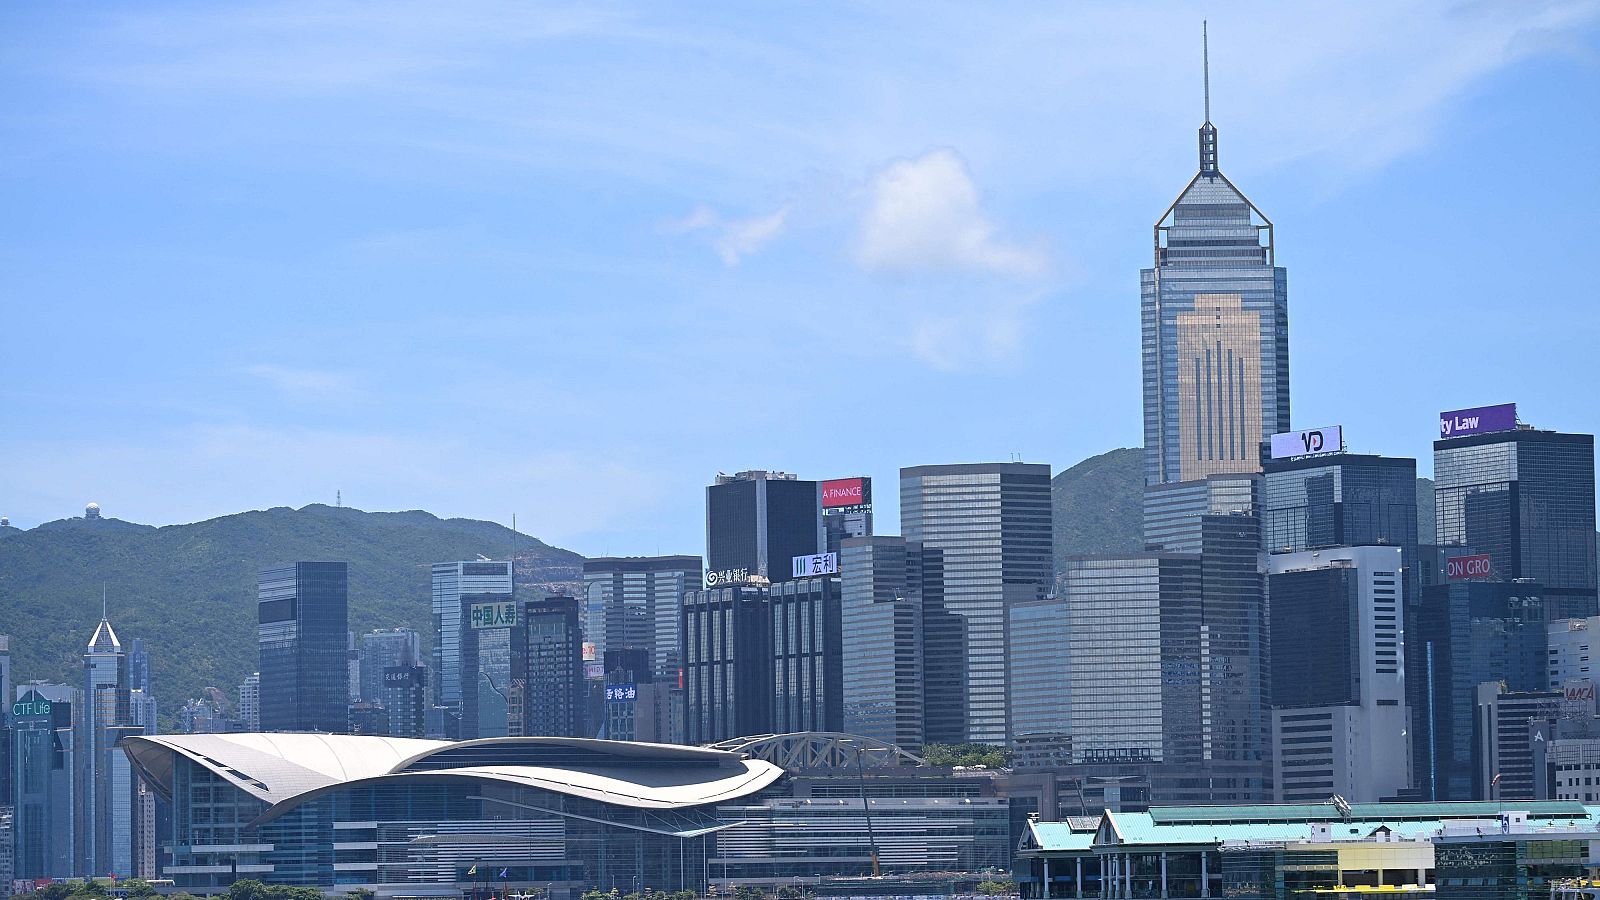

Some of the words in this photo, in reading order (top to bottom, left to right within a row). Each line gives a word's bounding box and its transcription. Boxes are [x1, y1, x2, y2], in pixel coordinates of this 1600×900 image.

[1441, 418, 1452, 434] ty
[1455, 416, 1479, 431] Law
[829, 487, 861, 498] FINANCE
[812, 555, 834, 574] 宏利
[1448, 561, 1464, 577] ON
[1466, 559, 1490, 575] GRO
[718, 568, 748, 583] 兴业银行
[472, 604, 516, 627] 中国人寿
[13, 703, 32, 716] CTF
[34, 702, 50, 715] Life
